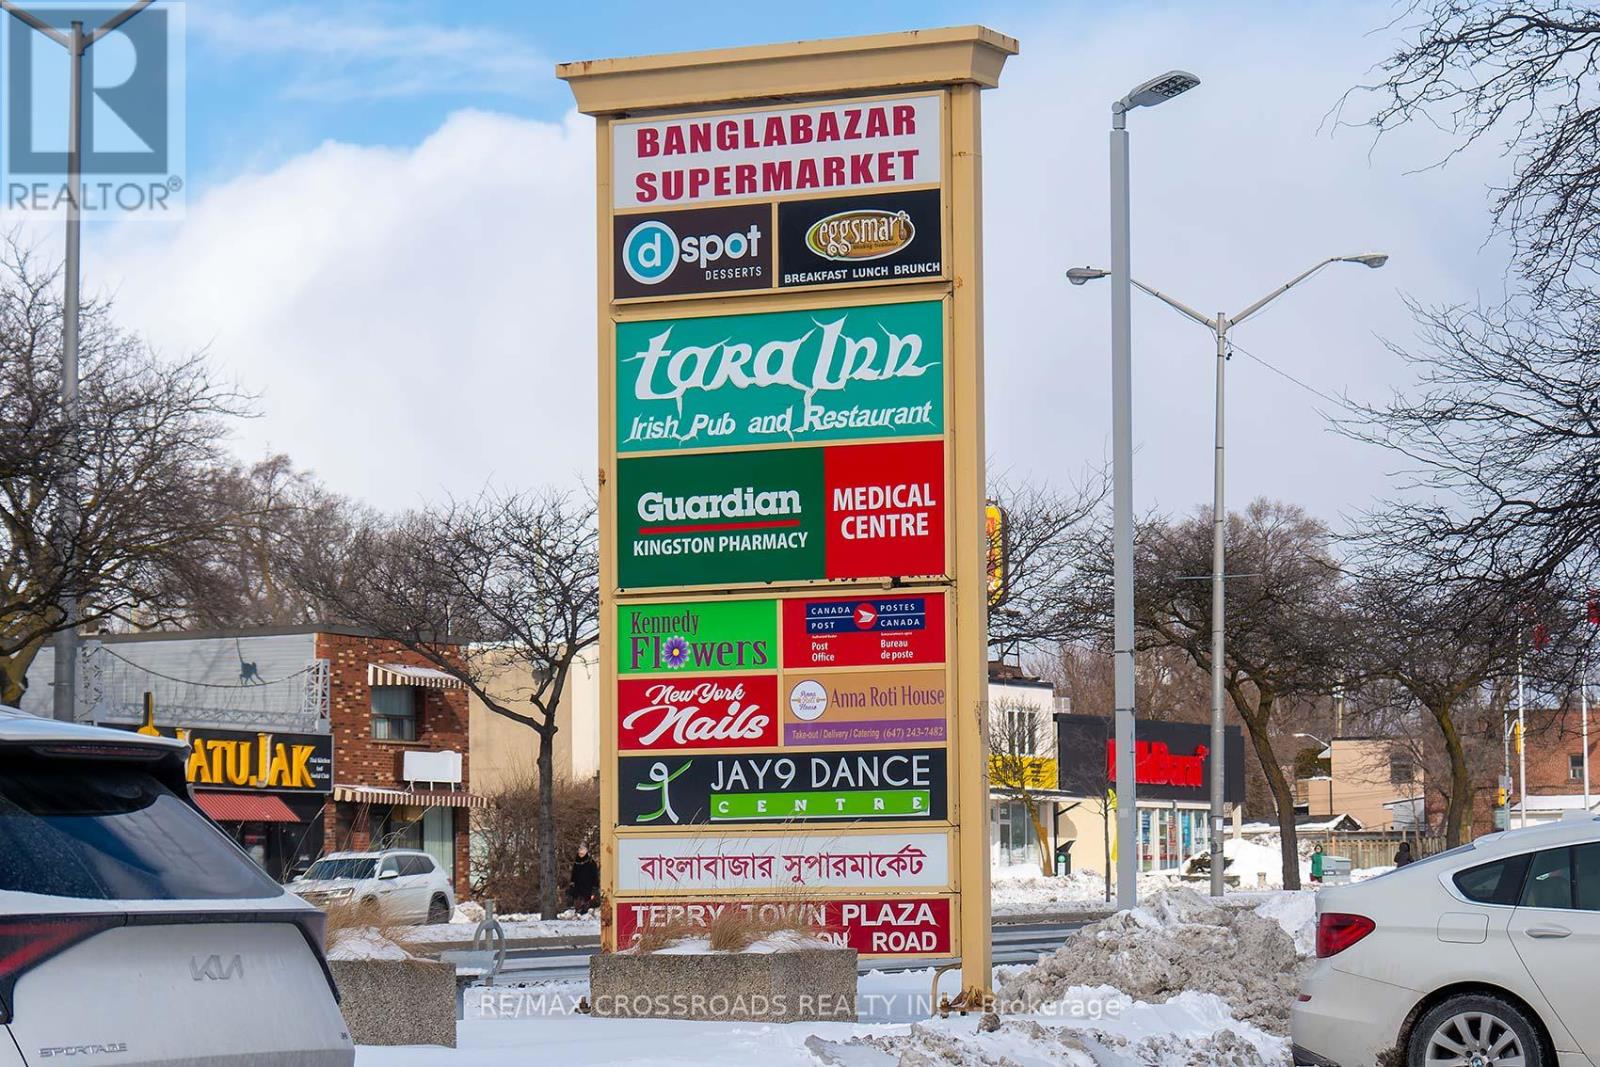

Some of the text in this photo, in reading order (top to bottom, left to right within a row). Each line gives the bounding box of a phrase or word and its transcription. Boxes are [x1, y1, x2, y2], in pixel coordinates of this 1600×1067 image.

[637, 104, 917, 158] BANGLABAZAR
[635, 149, 920, 203] SUPERMARKET
[818, 210, 911, 256] eggsmart
[705, 266, 763, 281] DESSERTS
[784, 262, 940, 284] BREAKFAST LUNCH BRUNCH
[622, 396, 937, 446] Irish Pub and Restaurant
[637, 486, 802, 522] Guardian
[832, 483, 937, 512] MEDICAL
[840, 512, 929, 540] CENTRE
[633, 531, 809, 557] KINGSTON PHARMACY
[811, 606, 851, 615] CANADA
[880, 603, 916, 612] POSTES
[630, 609, 701, 636] Kennedy
[811, 621, 836, 630] POST
[880, 617, 921, 627] CANADA
[811, 641, 829, 651] Post
[880, 639, 909, 648] Bureau
[880, 650, 914, 661] de poste
[811, 652, 836, 662] Office
[830, 685, 945, 709] Anna Roti House
[622, 701, 770, 746] Nails
[883, 728, 905, 739] (647)
[905, 726, 944, 738] 243-7482
[175, 728, 316, 788] ATUJAK
[710, 755, 930, 791] JAY9 DANCE
[638, 843, 927, 885] বাংলাবাজার সুপারমার্কেট
[631, 904, 725, 928] TERRY
[842, 903, 936, 927] PLAZA
[872, 931, 938, 951] ROAD
[40, 1042, 128, 1058] SPORTAGE
